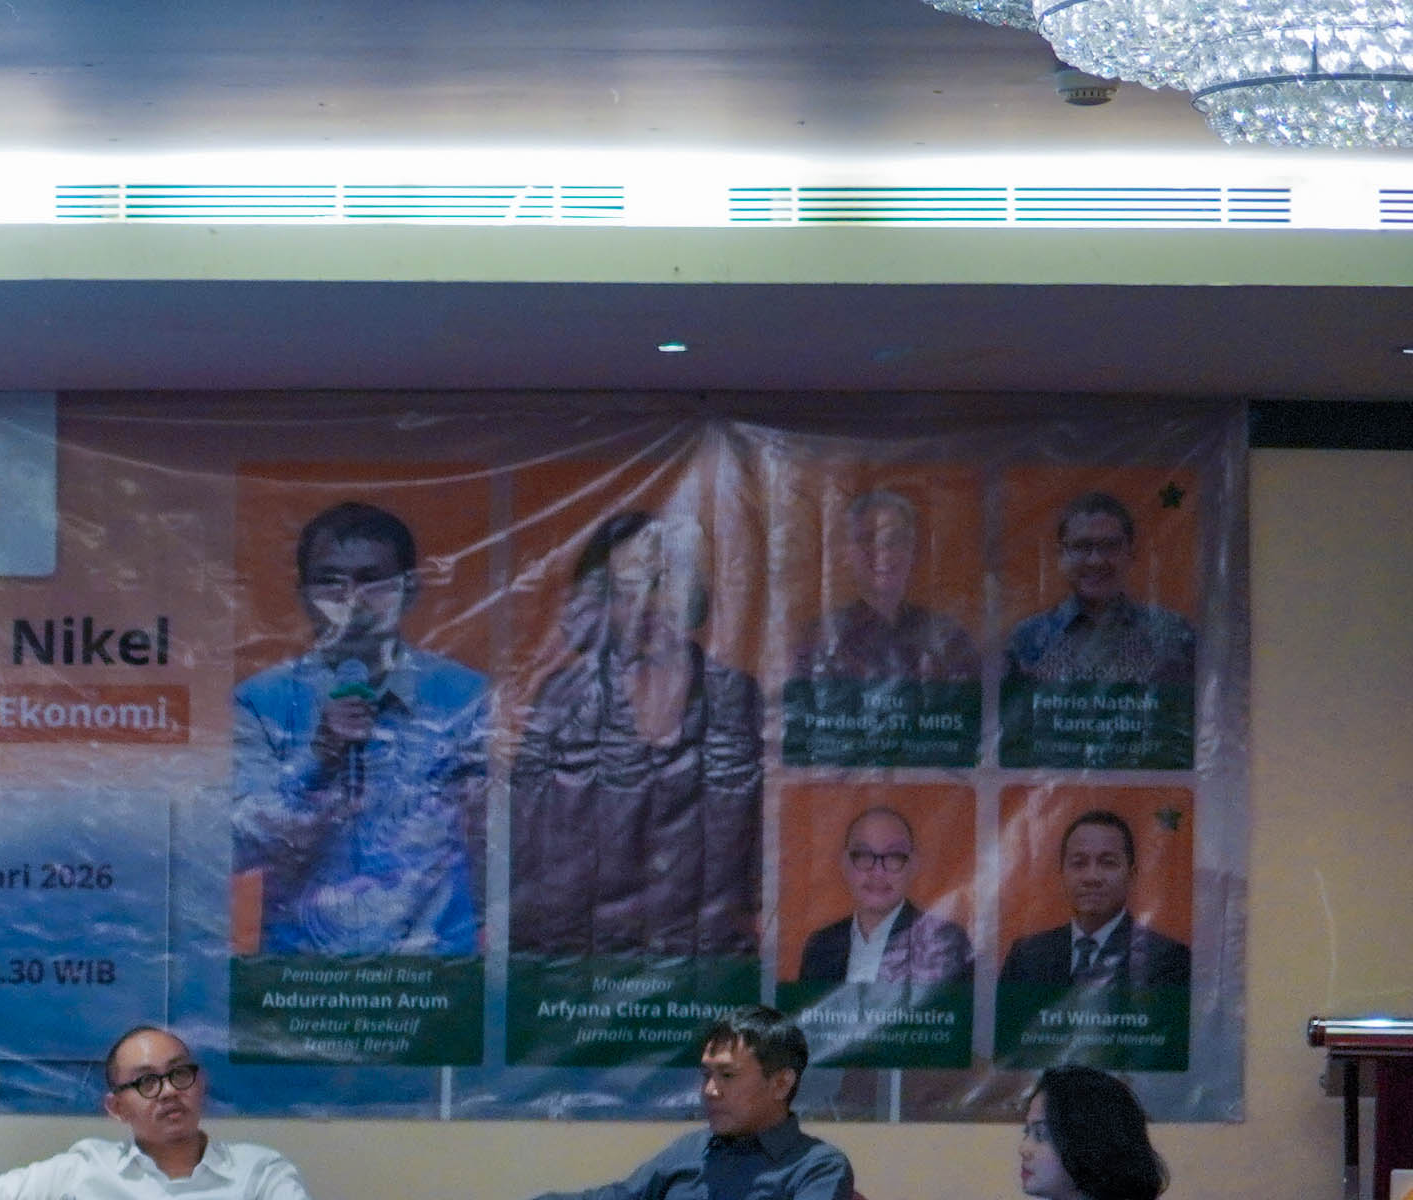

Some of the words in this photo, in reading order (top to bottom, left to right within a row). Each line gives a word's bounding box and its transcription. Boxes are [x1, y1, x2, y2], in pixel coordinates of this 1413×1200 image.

[12, 616, 170, 666] Nikel
[917, 713, 964, 731] MIDS
[40, 862, 114, 890] 2026
[52, 958, 116, 985] WIB
[281, 967, 351, 985] Pemapar
[354, 966, 393, 983] Hasil
[396, 967, 434, 983] Riset
[592, 976, 673, 993] Moderator
[261, 991, 393, 1009] Abdurrahman
[397, 992, 449, 1009] Arum
[536, 999, 612, 1022] Arfyana
[616, 1000, 662, 1018] Citra
[288, 1016, 351, 1034] Direktur
[353, 1016, 422, 1037] Eksekutif
[573, 1027, 634, 1045] Jurnalis
[637, 1027, 693, 1043] Kontan
